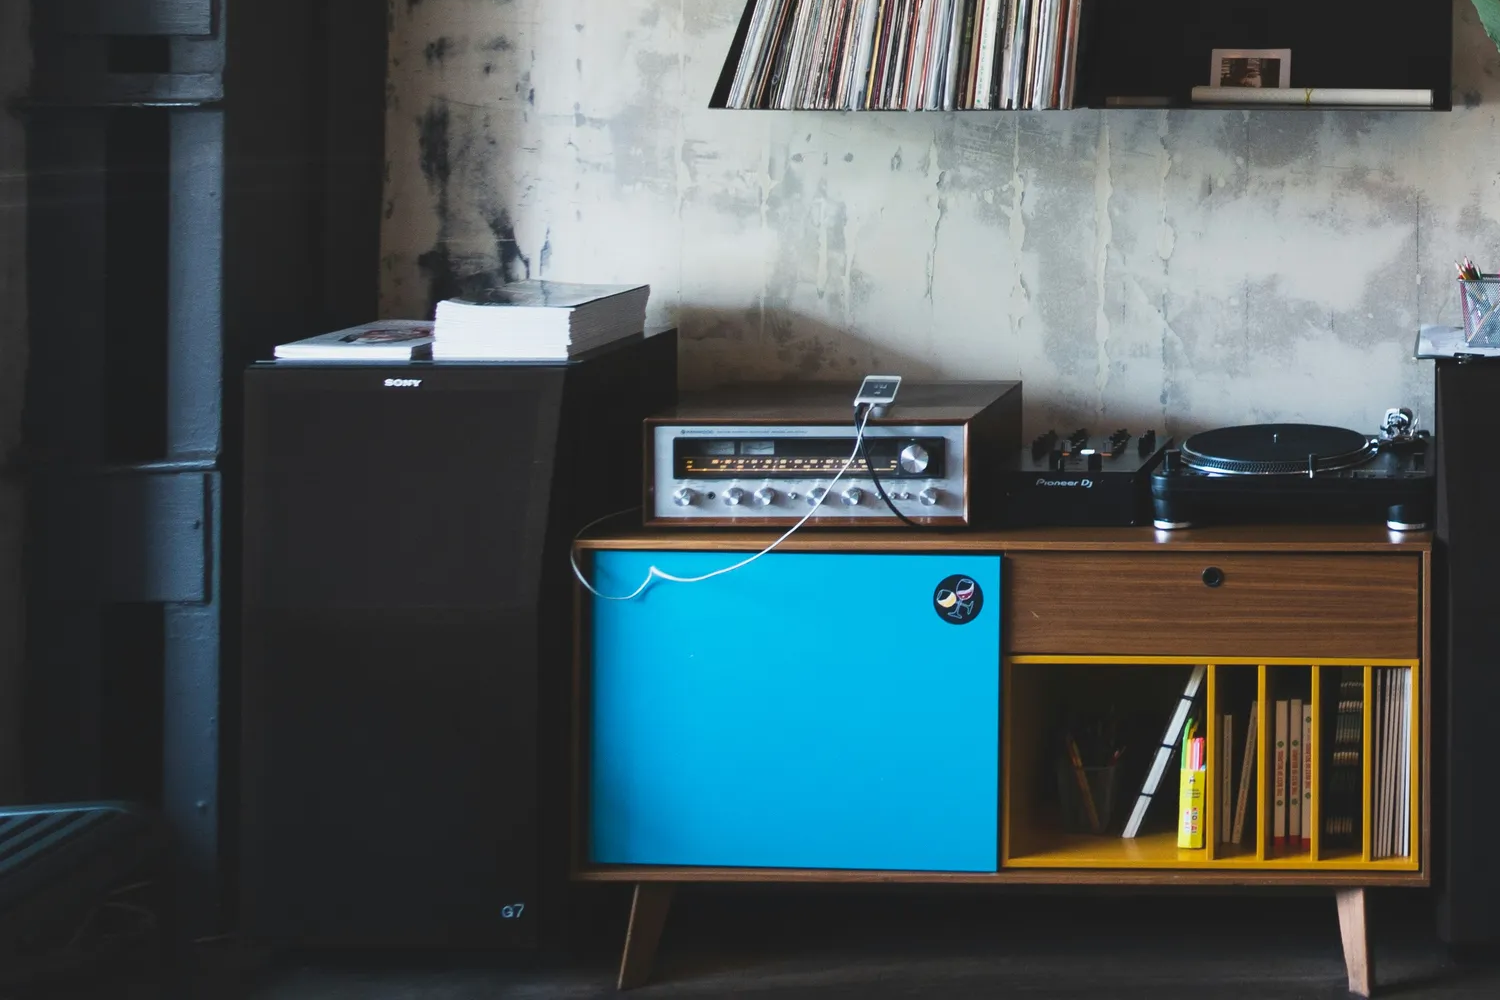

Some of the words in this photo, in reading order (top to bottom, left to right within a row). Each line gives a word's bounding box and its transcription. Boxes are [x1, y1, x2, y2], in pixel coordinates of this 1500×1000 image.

[384, 378, 422, 387] SONY
[1036, 478, 1079, 486] Pioneer
[501, 903, 525, 918] G7
